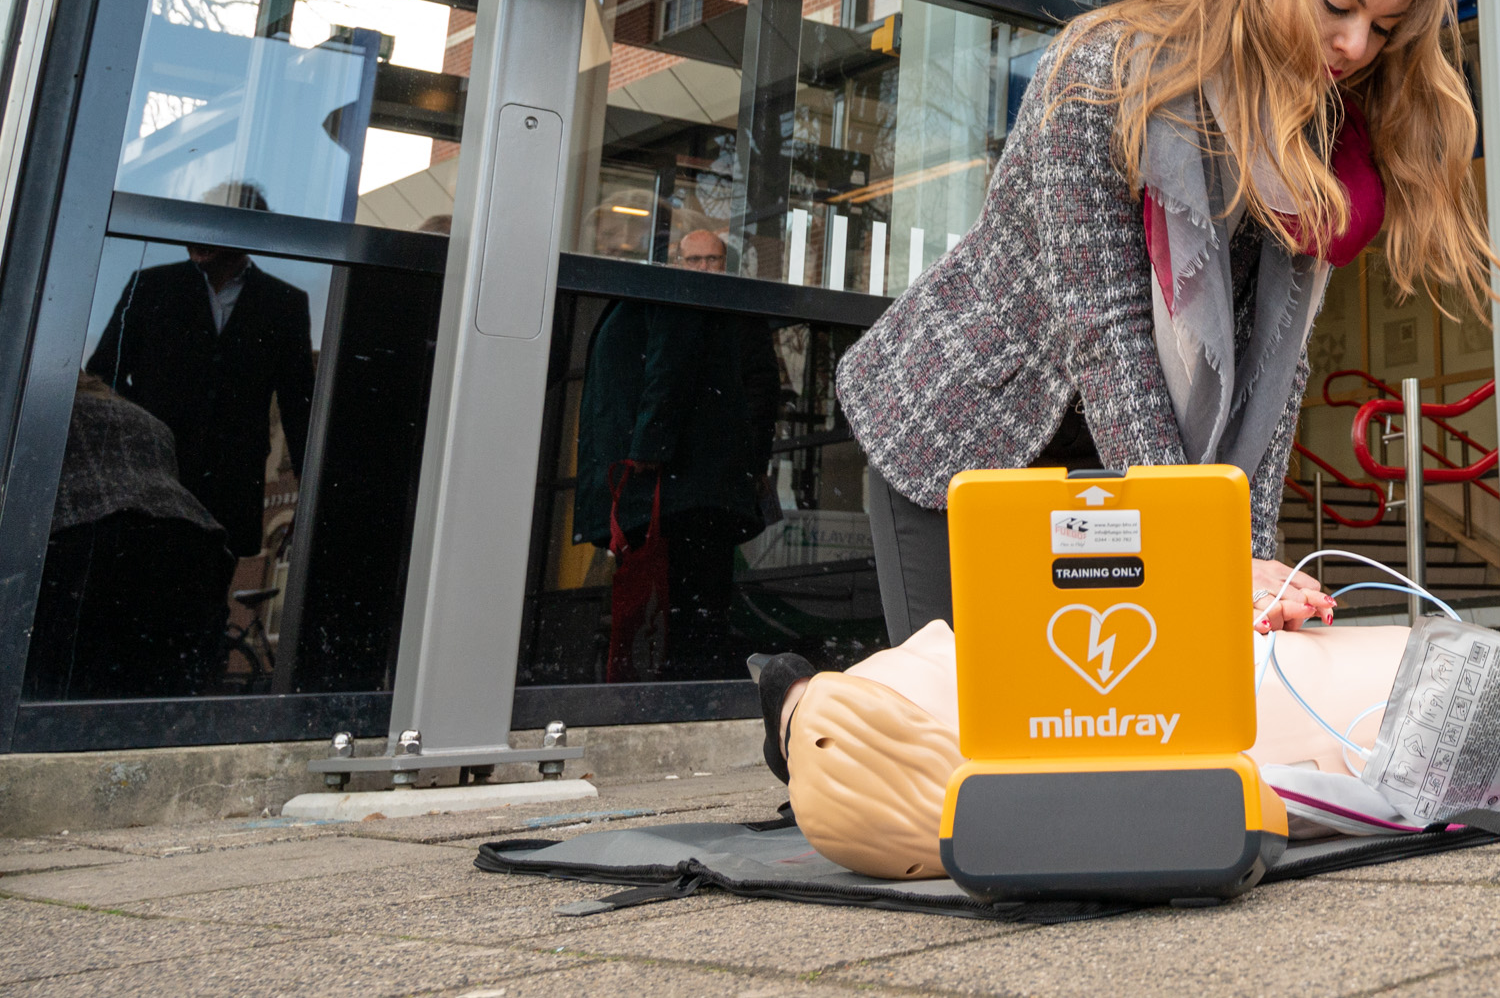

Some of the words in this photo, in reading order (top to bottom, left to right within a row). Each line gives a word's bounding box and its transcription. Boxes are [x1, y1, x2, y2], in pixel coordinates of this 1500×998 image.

[1055, 568, 1110, 579] TRAINING
[1111, 567, 1142, 577] ONLY
[1028, 707, 1181, 744] mindray
